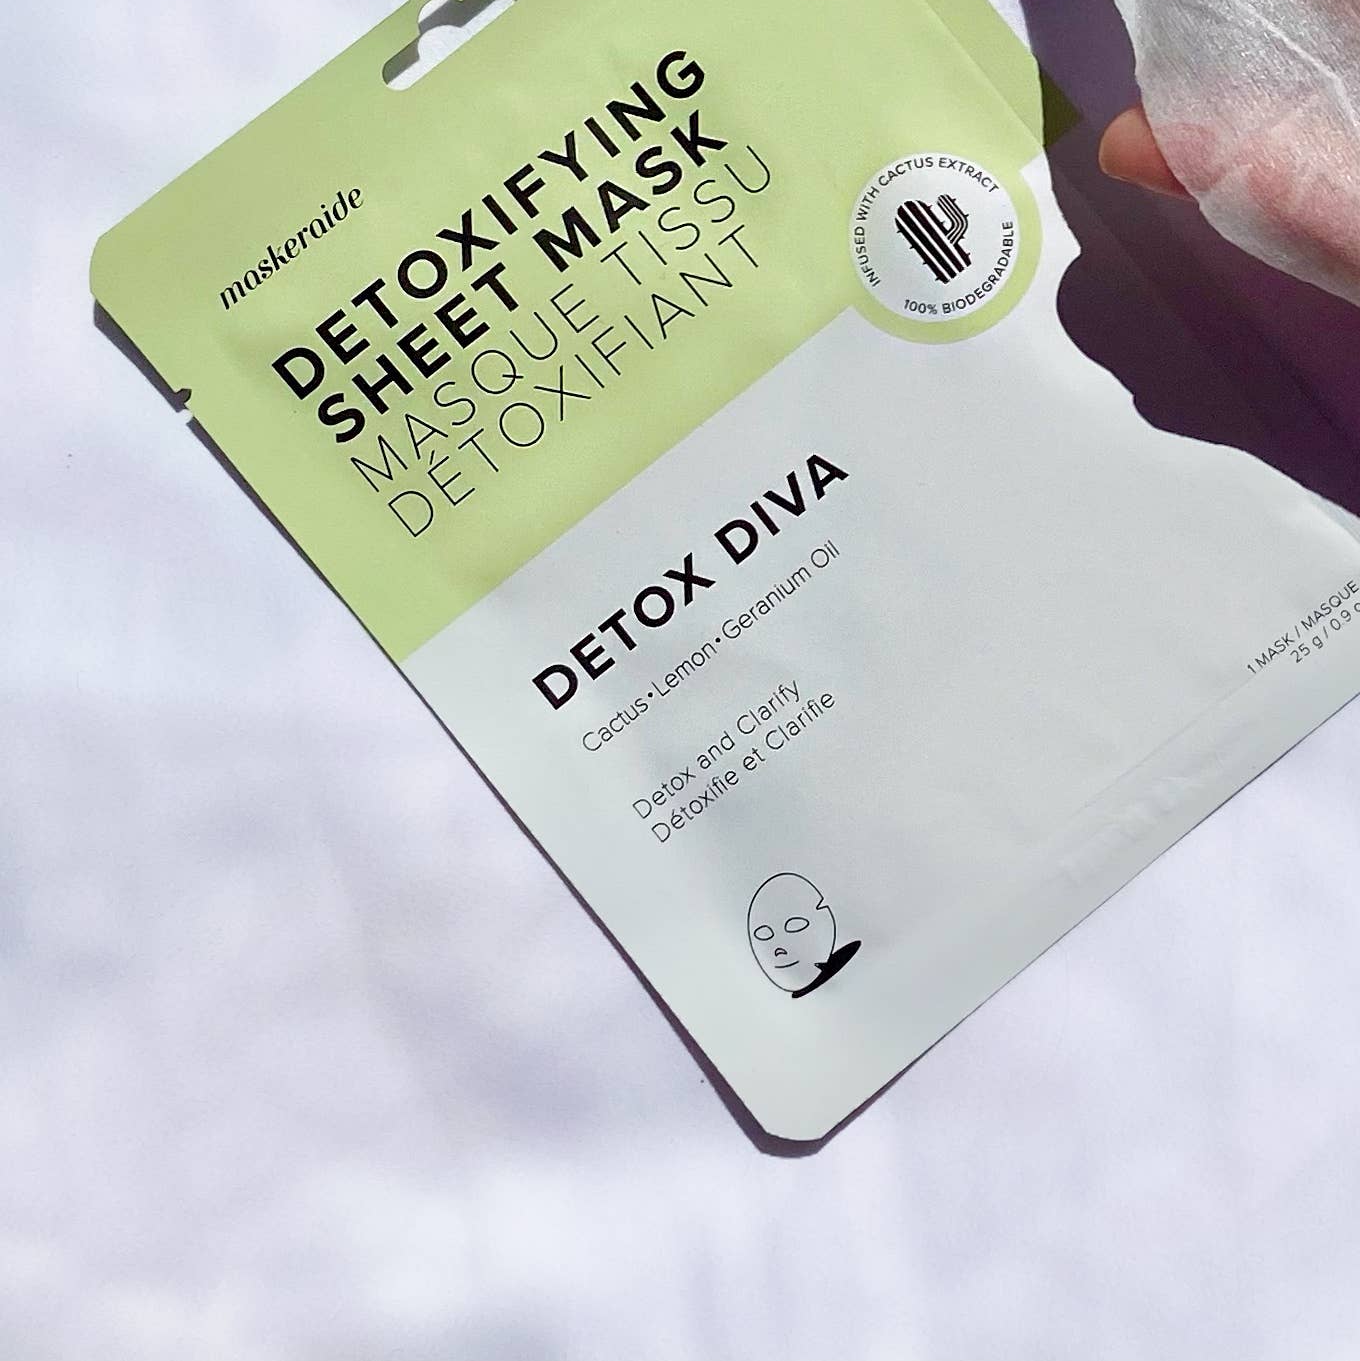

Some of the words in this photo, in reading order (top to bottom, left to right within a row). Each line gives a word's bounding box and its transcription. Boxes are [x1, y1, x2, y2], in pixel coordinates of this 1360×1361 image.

[271, 50, 705, 401] DETOXIFYING
[855, 185, 880, 221] WITH
[878, 156, 934, 187] CACTUS
[938, 157, 1000, 193] EXTRACT
[219, 188, 364, 310] maskeraide
[317, 261, 520, 444] SHEET
[531, 109, 729, 273] MASK
[854, 226, 881, 287] INFUSED
[904, 299, 938, 315] 100%
[941, 221, 1014, 315] BIODEGRADABLE
[350, 283, 600, 493] MASQUE
[599, 145, 771, 286] TISSU
[387, 224, 759, 538] DÉTOXIFIANT
[531, 551, 717, 711] DETOX
[713, 454, 850, 566] DIVA
[810, 539, 840, 569] Oil
[1247, 664, 1257, 674] 1
[1254, 632, 1295, 668] MASK
[1300, 580, 1360, 631] MASQUE
[1289, 642, 1311, 664] 25
[1311, 635, 1324, 650] g
[632, 766, 697, 820] Detox
[696, 730, 736, 770] and
[736, 680, 800, 735] Clarify
[651, 770, 740, 843] Détoxifie
[742, 747, 766, 771] et
[765, 693, 835, 750] Clarifie
